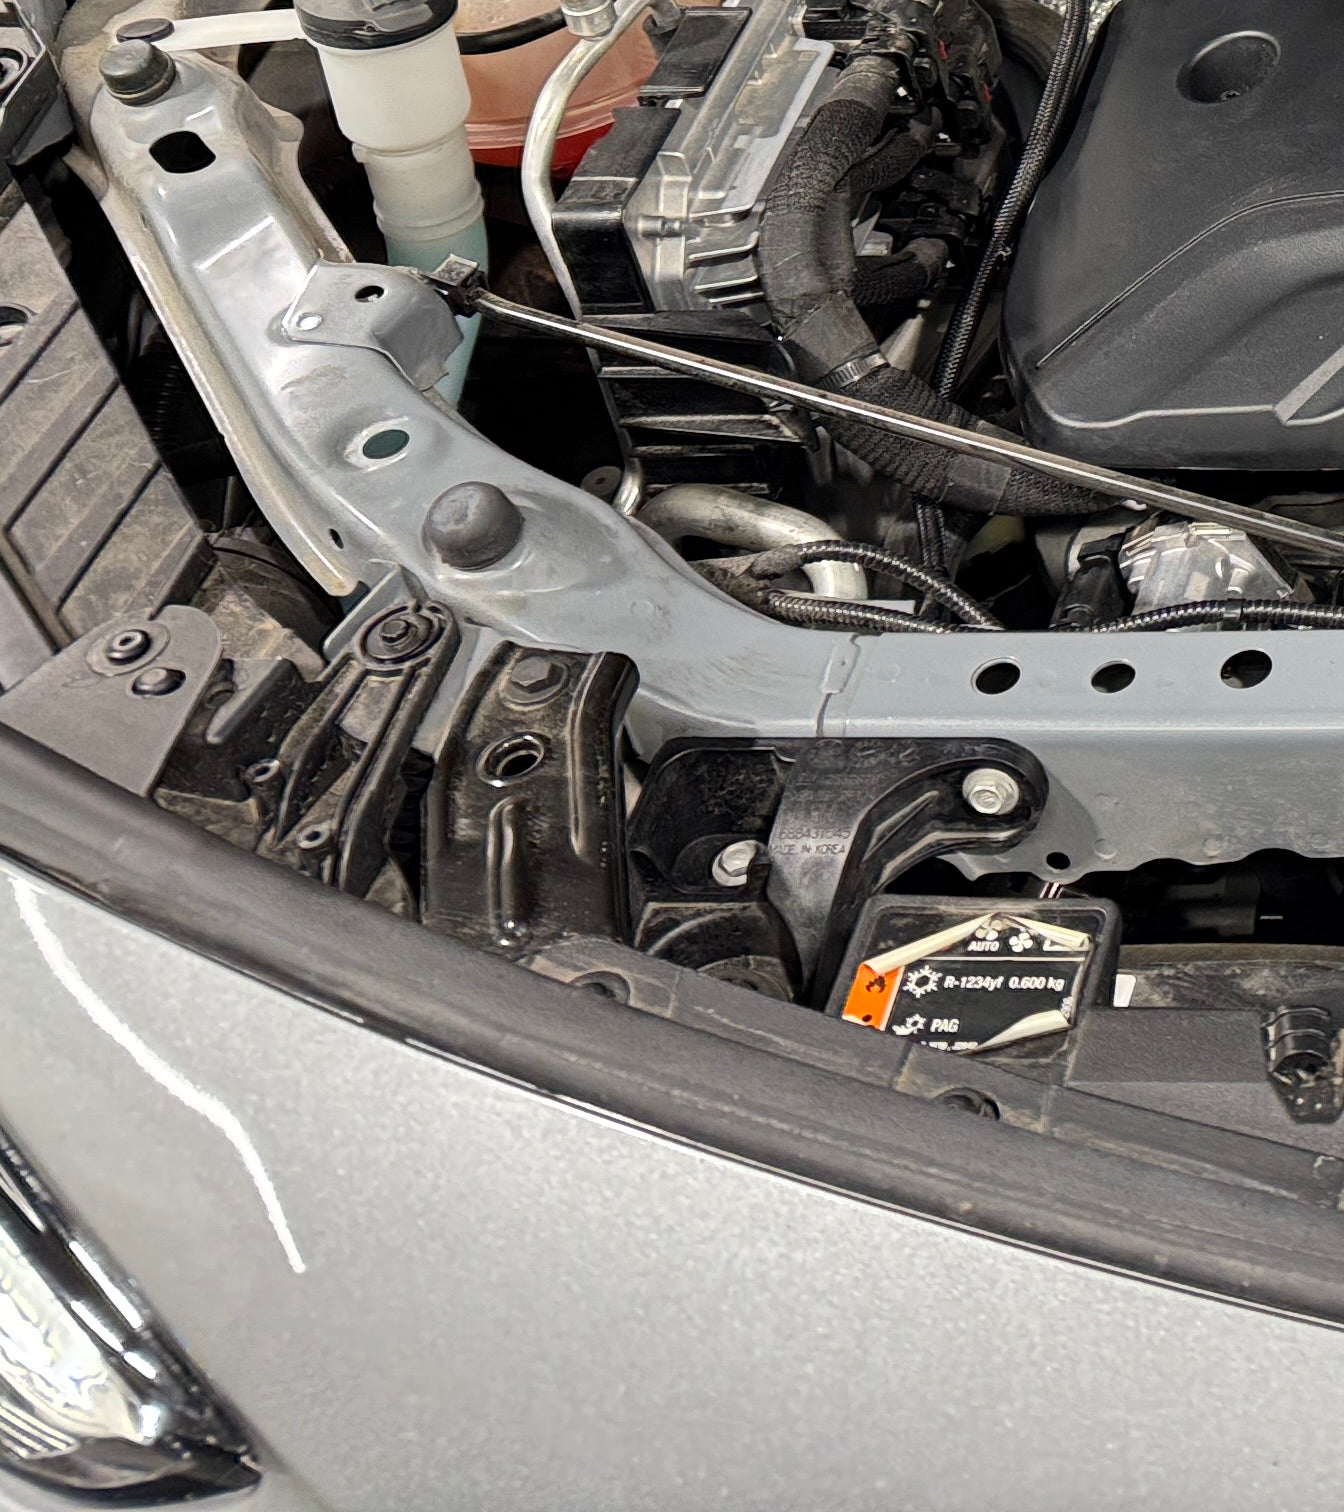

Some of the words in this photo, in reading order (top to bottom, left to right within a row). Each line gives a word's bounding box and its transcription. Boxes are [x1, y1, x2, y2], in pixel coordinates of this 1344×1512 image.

[967, 940, 1001, 952] AUTO
[943, 975, 1005, 992] R-1234yf
[1008, 976, 1047, 990] 0.600
[1047, 976, 1066, 992] kg
[929, 1018, 961, 1033] PAG
